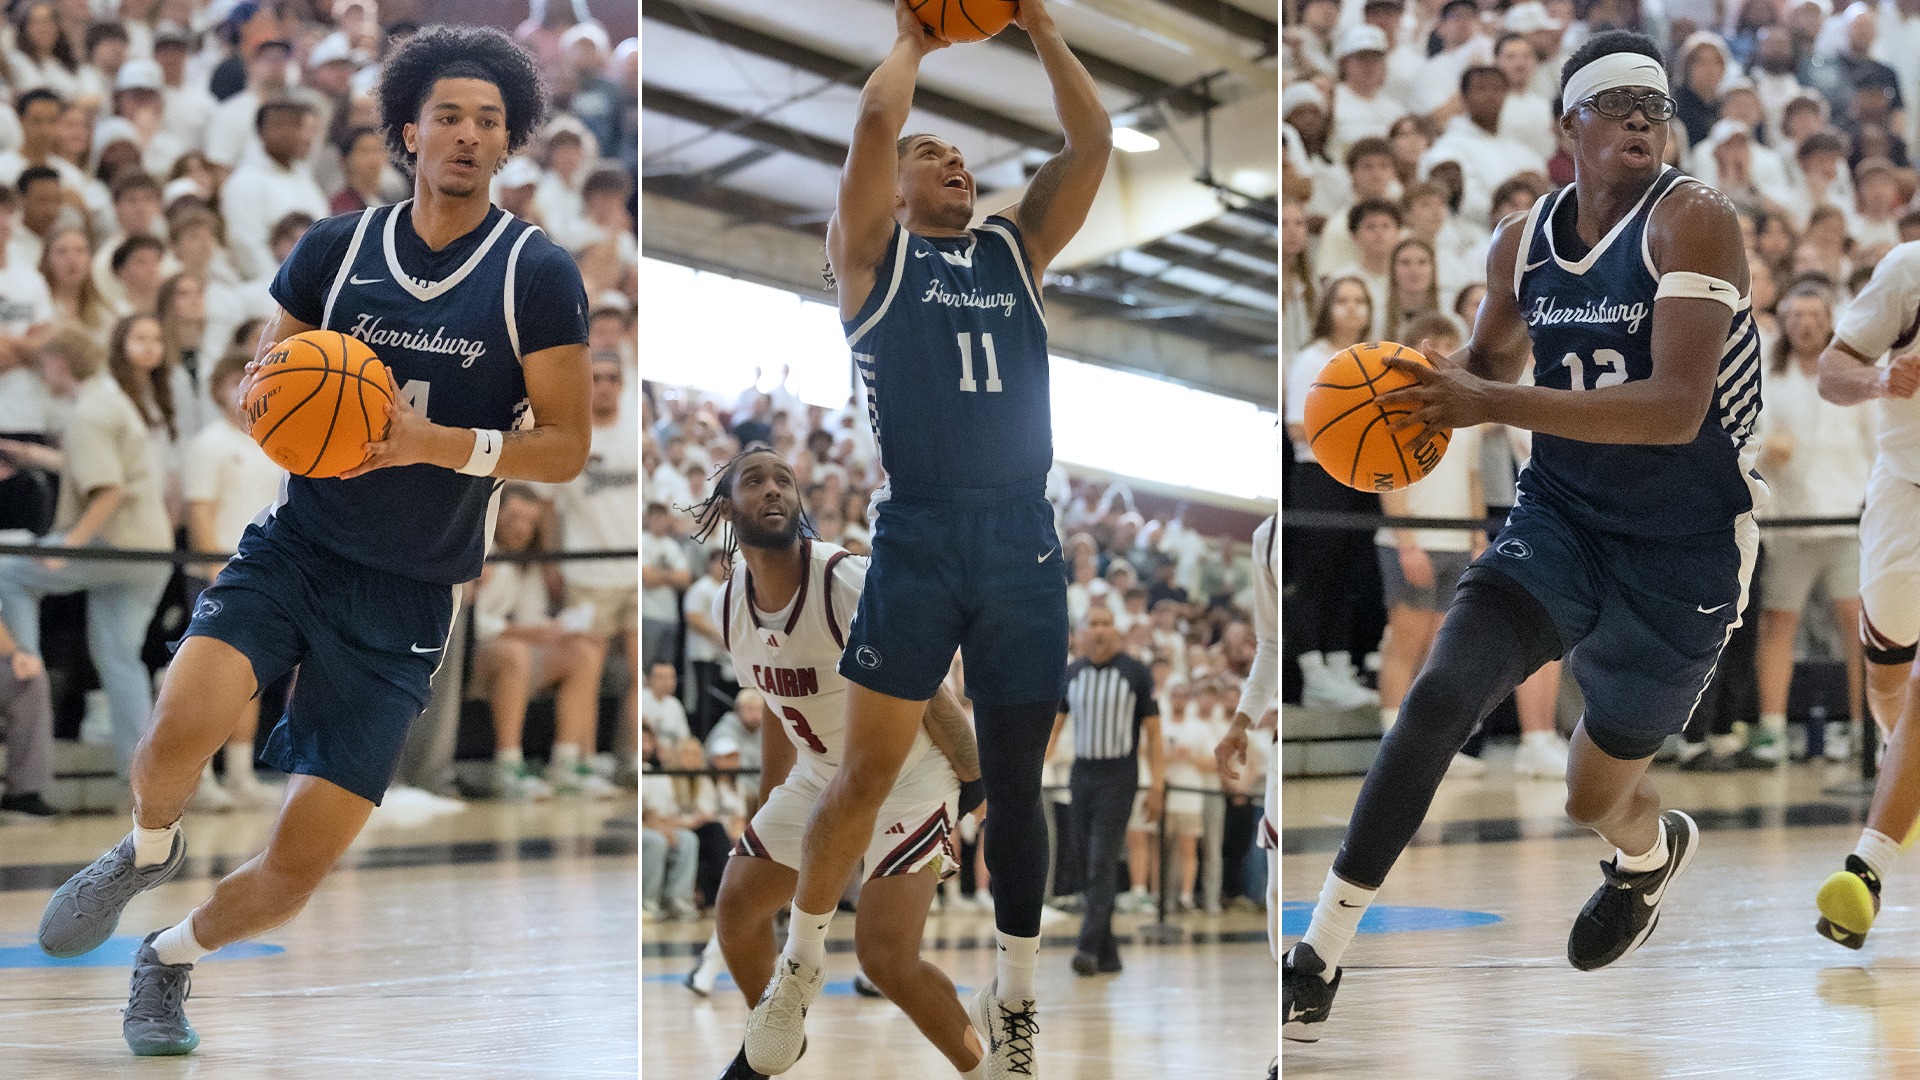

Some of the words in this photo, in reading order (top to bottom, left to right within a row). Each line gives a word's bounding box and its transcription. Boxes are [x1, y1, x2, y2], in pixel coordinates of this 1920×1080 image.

[1529, 296, 1649, 334] Harrisburg
[350, 313, 487, 369] Harrisburg
[957, 332, 1003, 393] 11
[1562, 348, 1629, 391] 12
[753, 665, 819, 697] CAIRN
[781, 705, 828, 754] 3
